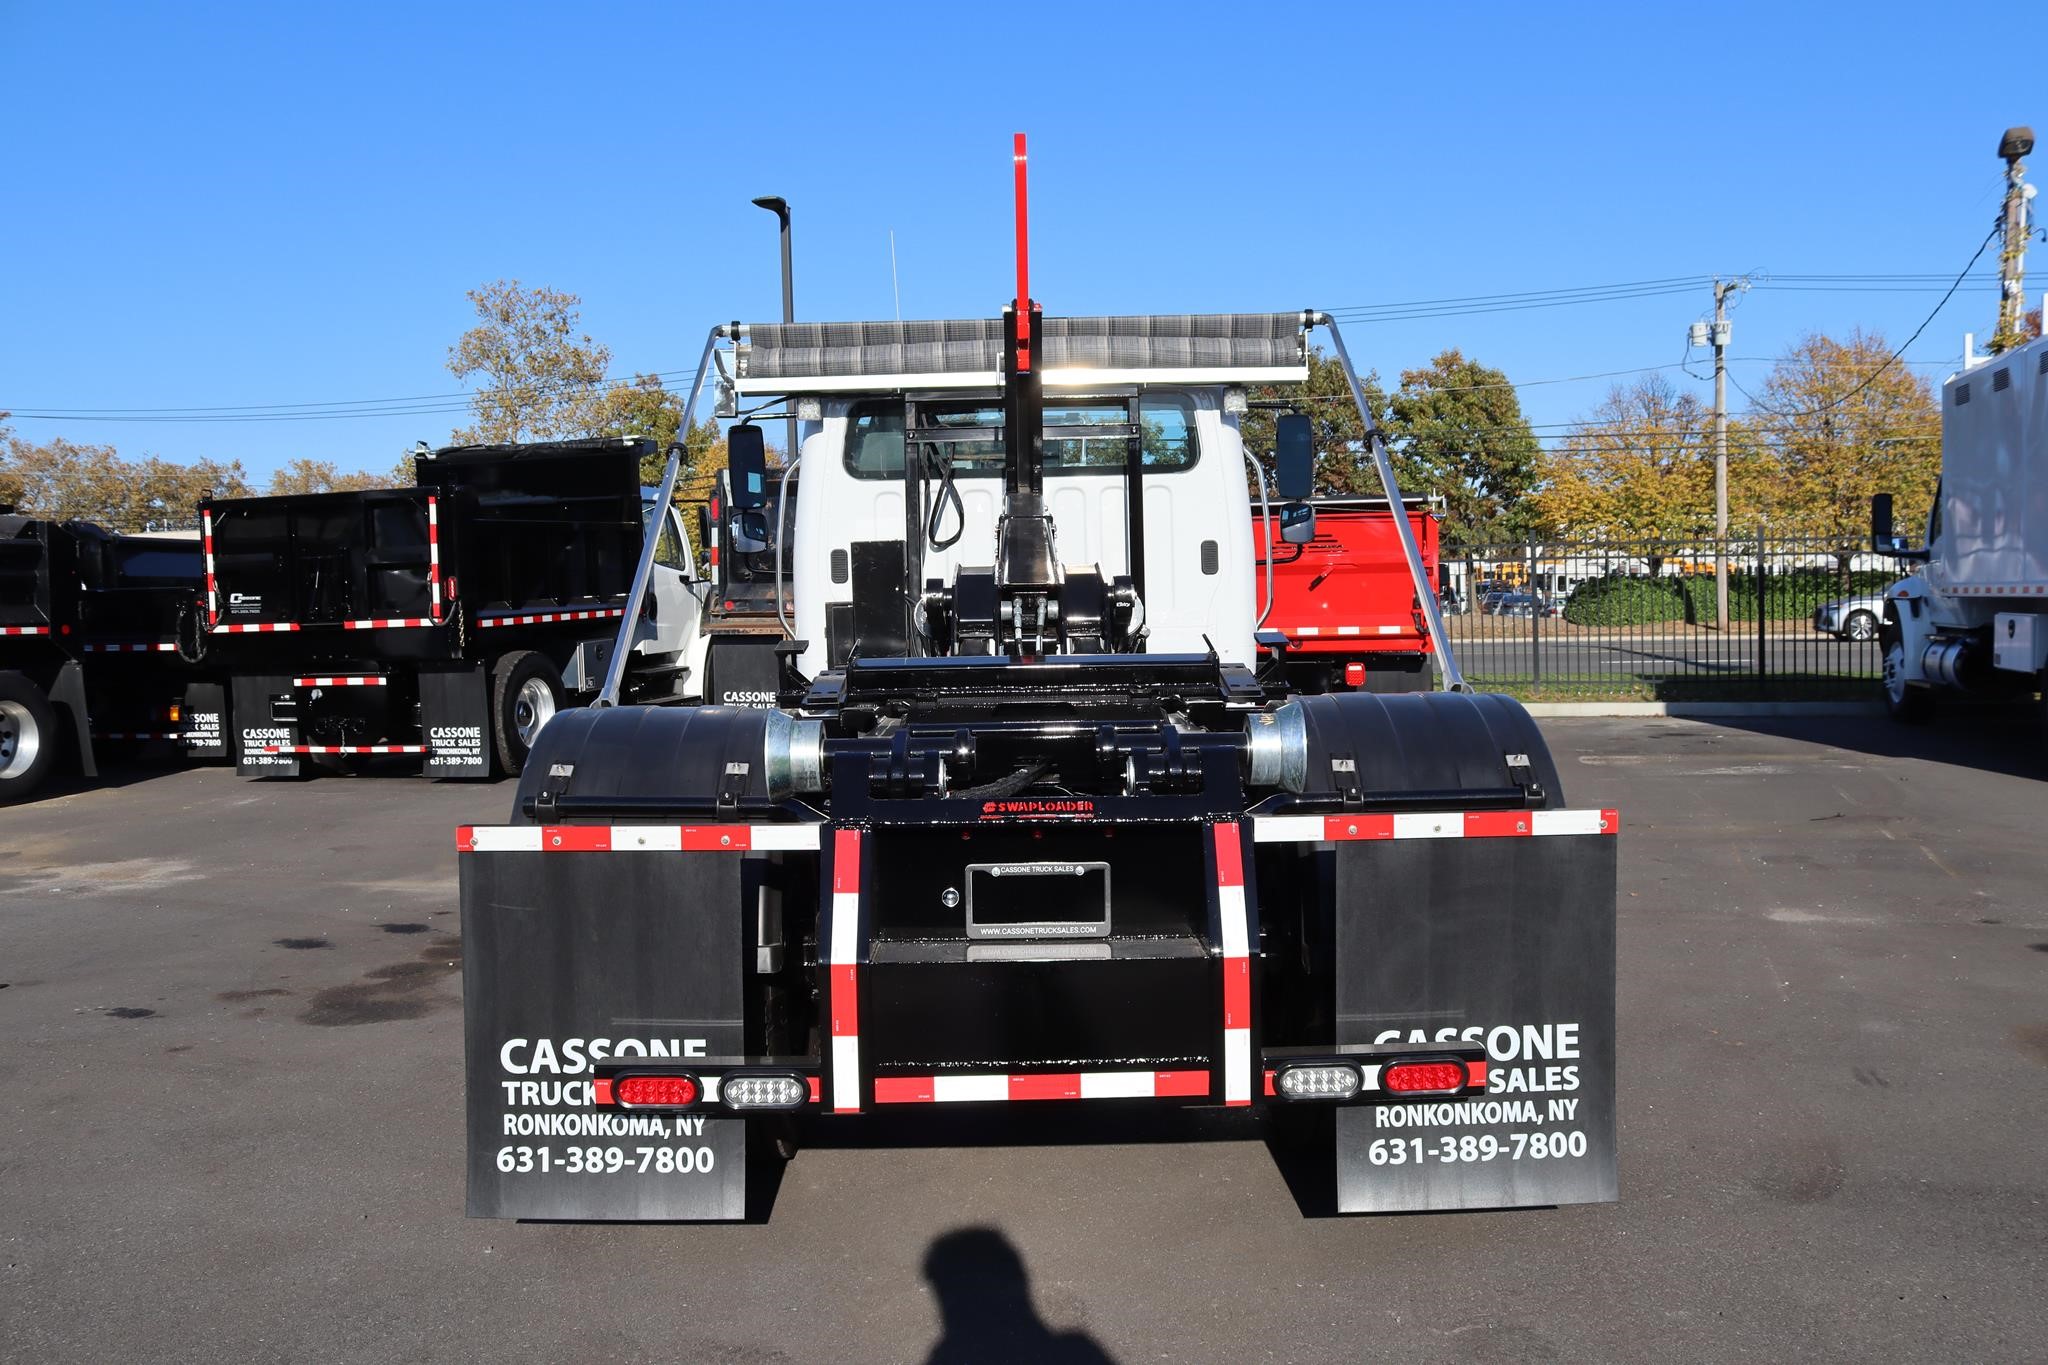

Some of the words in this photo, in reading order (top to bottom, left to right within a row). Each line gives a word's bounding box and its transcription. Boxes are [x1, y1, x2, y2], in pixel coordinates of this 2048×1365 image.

[723, 691, 776, 702] CASSONE
[243, 728, 290, 739] CASSONE
[430, 726, 480, 738] CASSONE
[431, 738, 456, 746] TRUCK
[458, 738, 480, 746] SALES
[998, 801, 1094, 812] SWAPLOADER
[980, 926, 1097, 935] WWW.CASSONETRUCKSALES.COM
[1489, 1065, 1580, 1094] SALES
[1375, 1101, 1544, 1128] RONKONKOMA,
[1548, 1098, 1579, 1122] NY
[503, 1113, 671, 1139] RONKONKOMA,
[675, 1114, 707, 1136] NY
[1368, 1130, 1588, 1166] 631-389-7800
[496, 1146, 715, 1174] 631-389-7800
